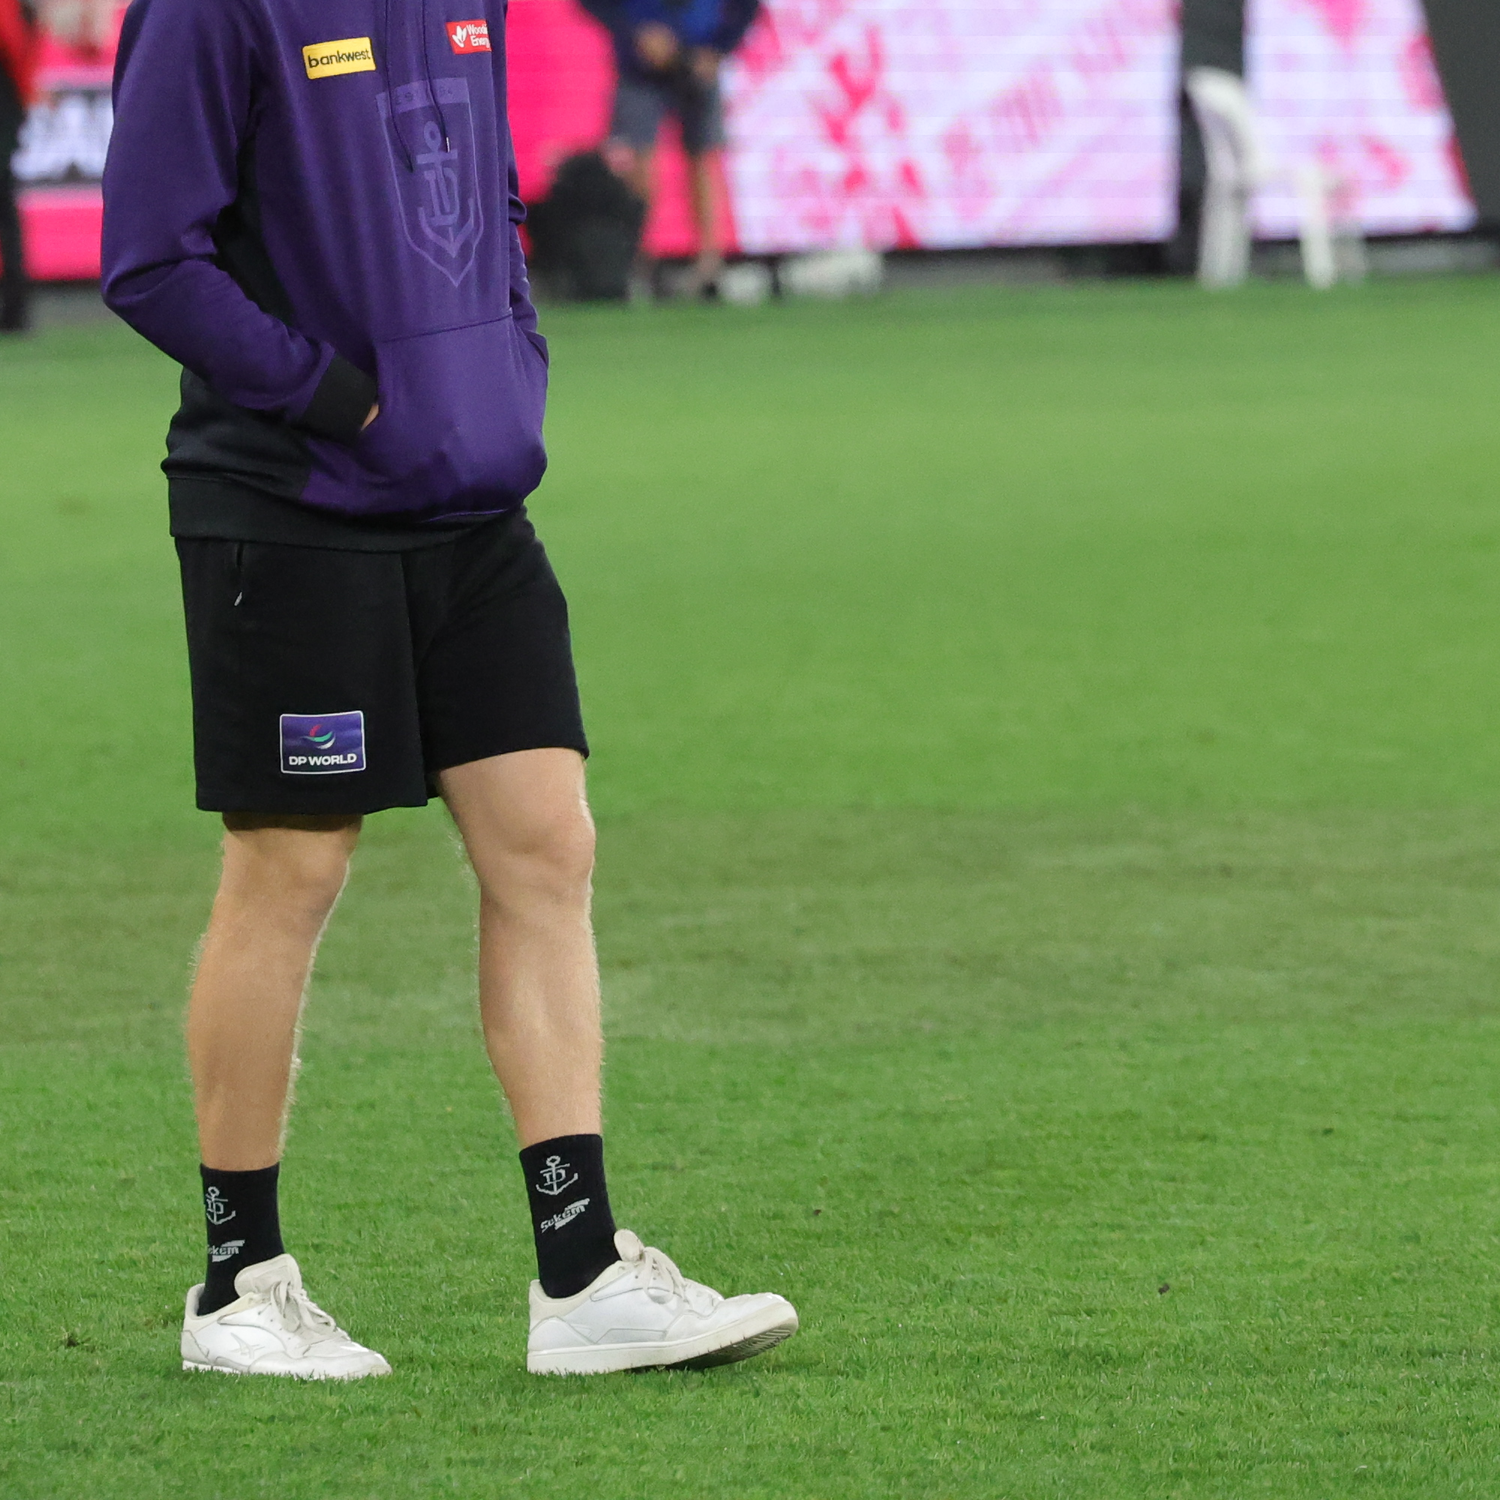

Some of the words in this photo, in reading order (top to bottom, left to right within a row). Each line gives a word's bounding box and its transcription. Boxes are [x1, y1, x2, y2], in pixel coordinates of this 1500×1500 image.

[308, 48, 371, 68] bankwest
[289, 756, 307, 765] DP
[308, 754, 357, 765] WORLD
